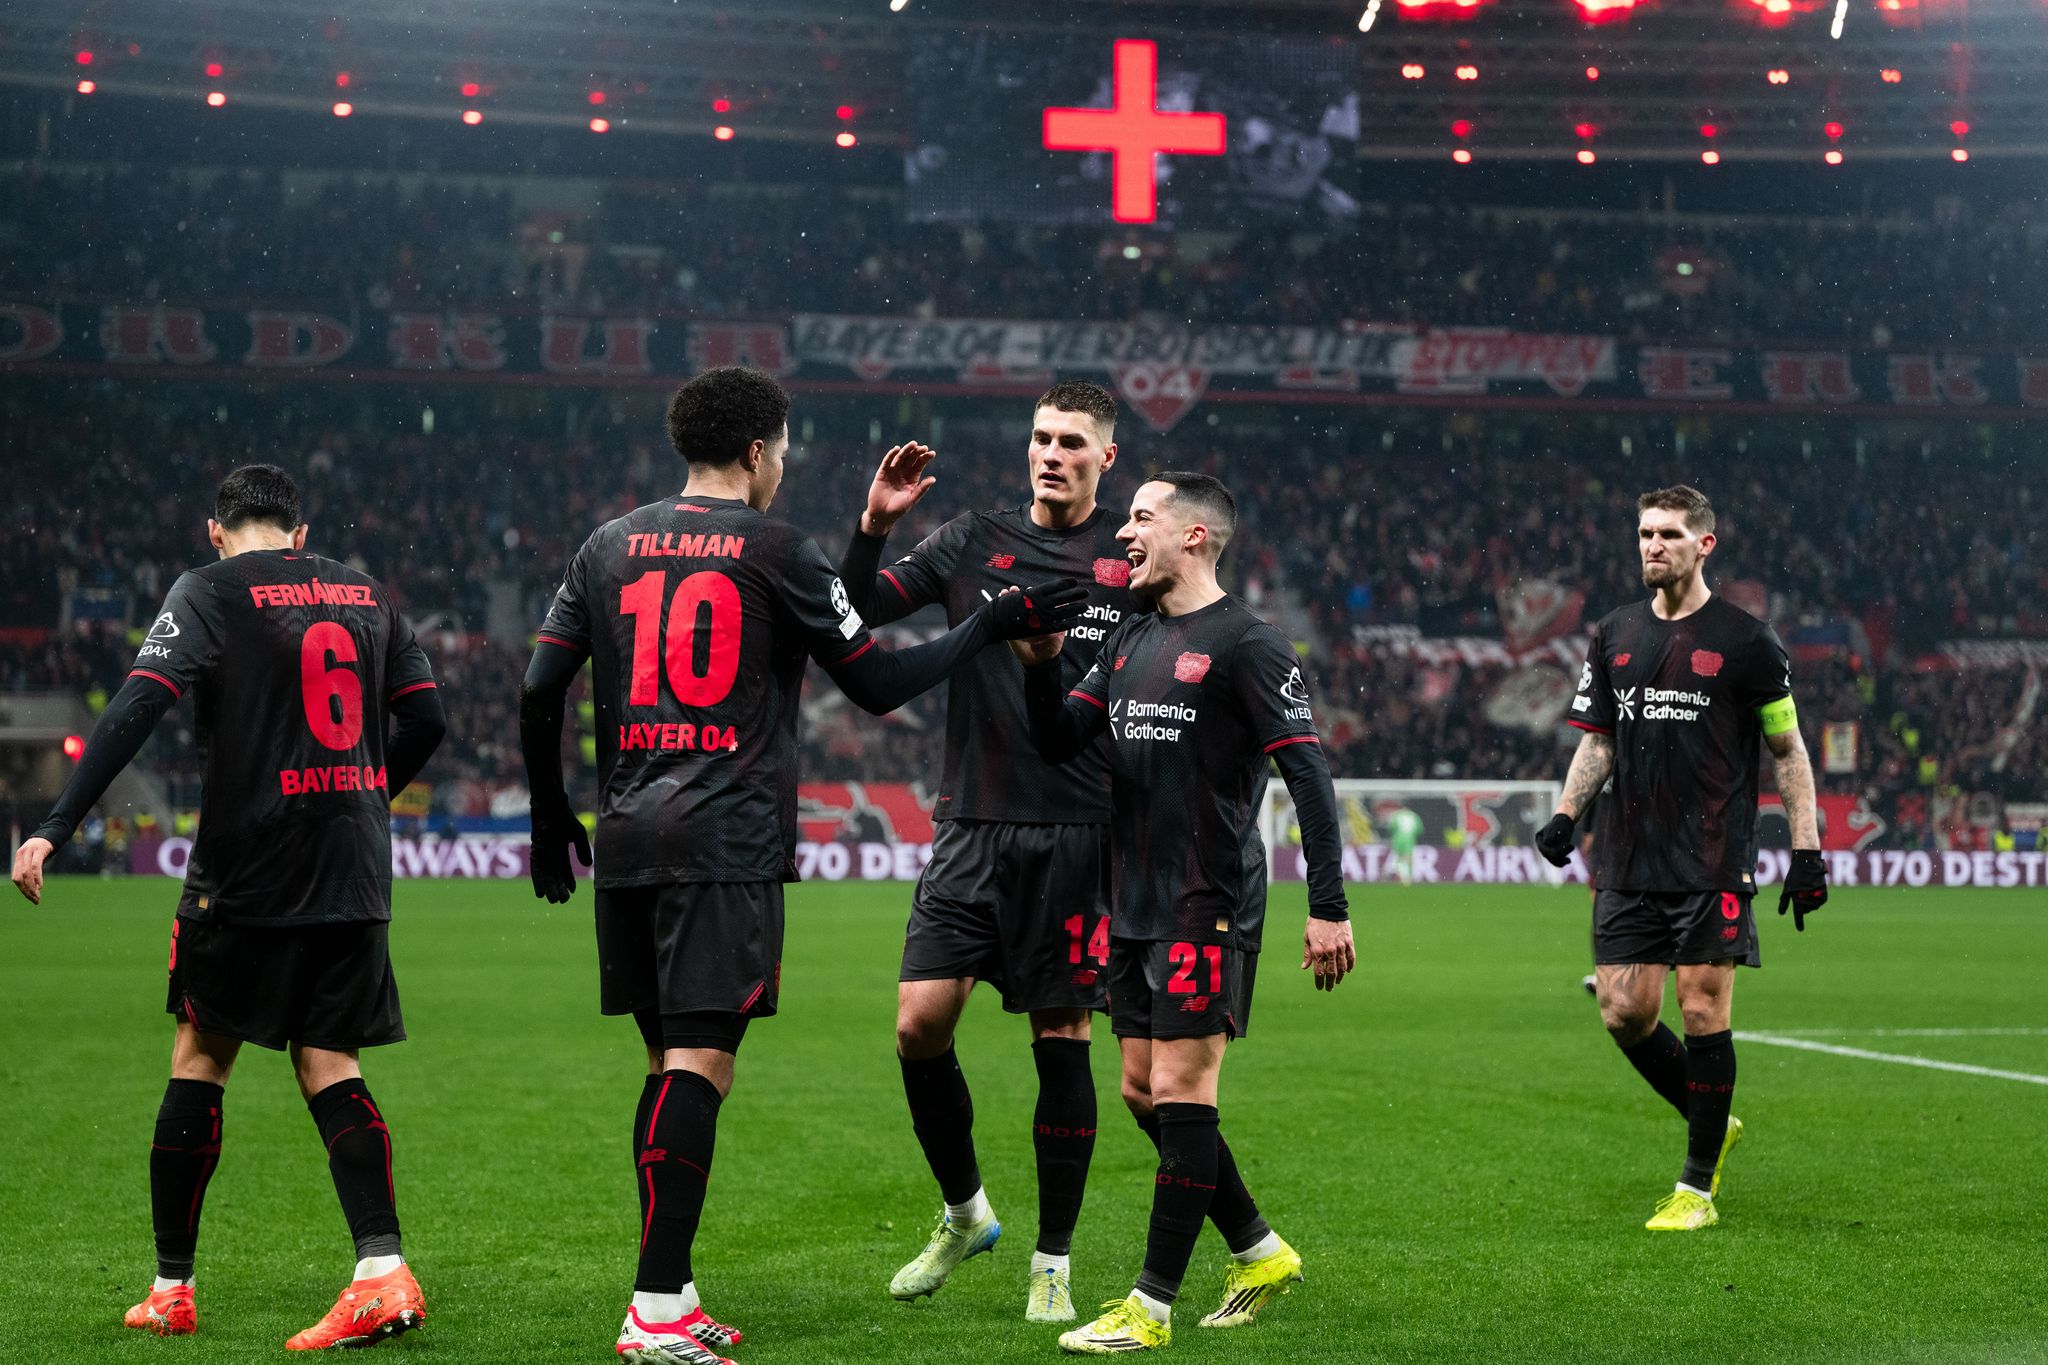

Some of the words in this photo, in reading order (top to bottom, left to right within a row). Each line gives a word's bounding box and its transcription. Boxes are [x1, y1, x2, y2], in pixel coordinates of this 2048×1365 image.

[1121, 366, 1193, 402] 04
[628, 532, 744, 559] TILLMAN
[250, 577, 377, 608] FERNÁNDEZ
[1077, 604, 1121, 623] enia
[137, 645, 171, 659] EDAX
[619, 570, 743, 708] 10
[301, 621, 363, 751] 6
[1644, 687, 1710, 706] Barmenia
[1127, 699, 1197, 722] Barmenia
[1284, 707, 1313, 720] NIED
[1642, 704, 1700, 721] Gothaer
[701, 726, 738, 752] 04
[1124, 722, 1182, 742] Gothaer
[280, 766, 363, 796] BAYER
[363, 765, 388, 792] 04
[795, 842, 850, 881] 70
[1295, 844, 1440, 882] ATAR
[1453, 845, 1590, 883] AIRWA
[1868, 850, 1931, 887] 170
[1942, 850, 2048, 887] DEST
[1064, 914, 1111, 966] 14
[1167, 941, 1222, 994] 21
